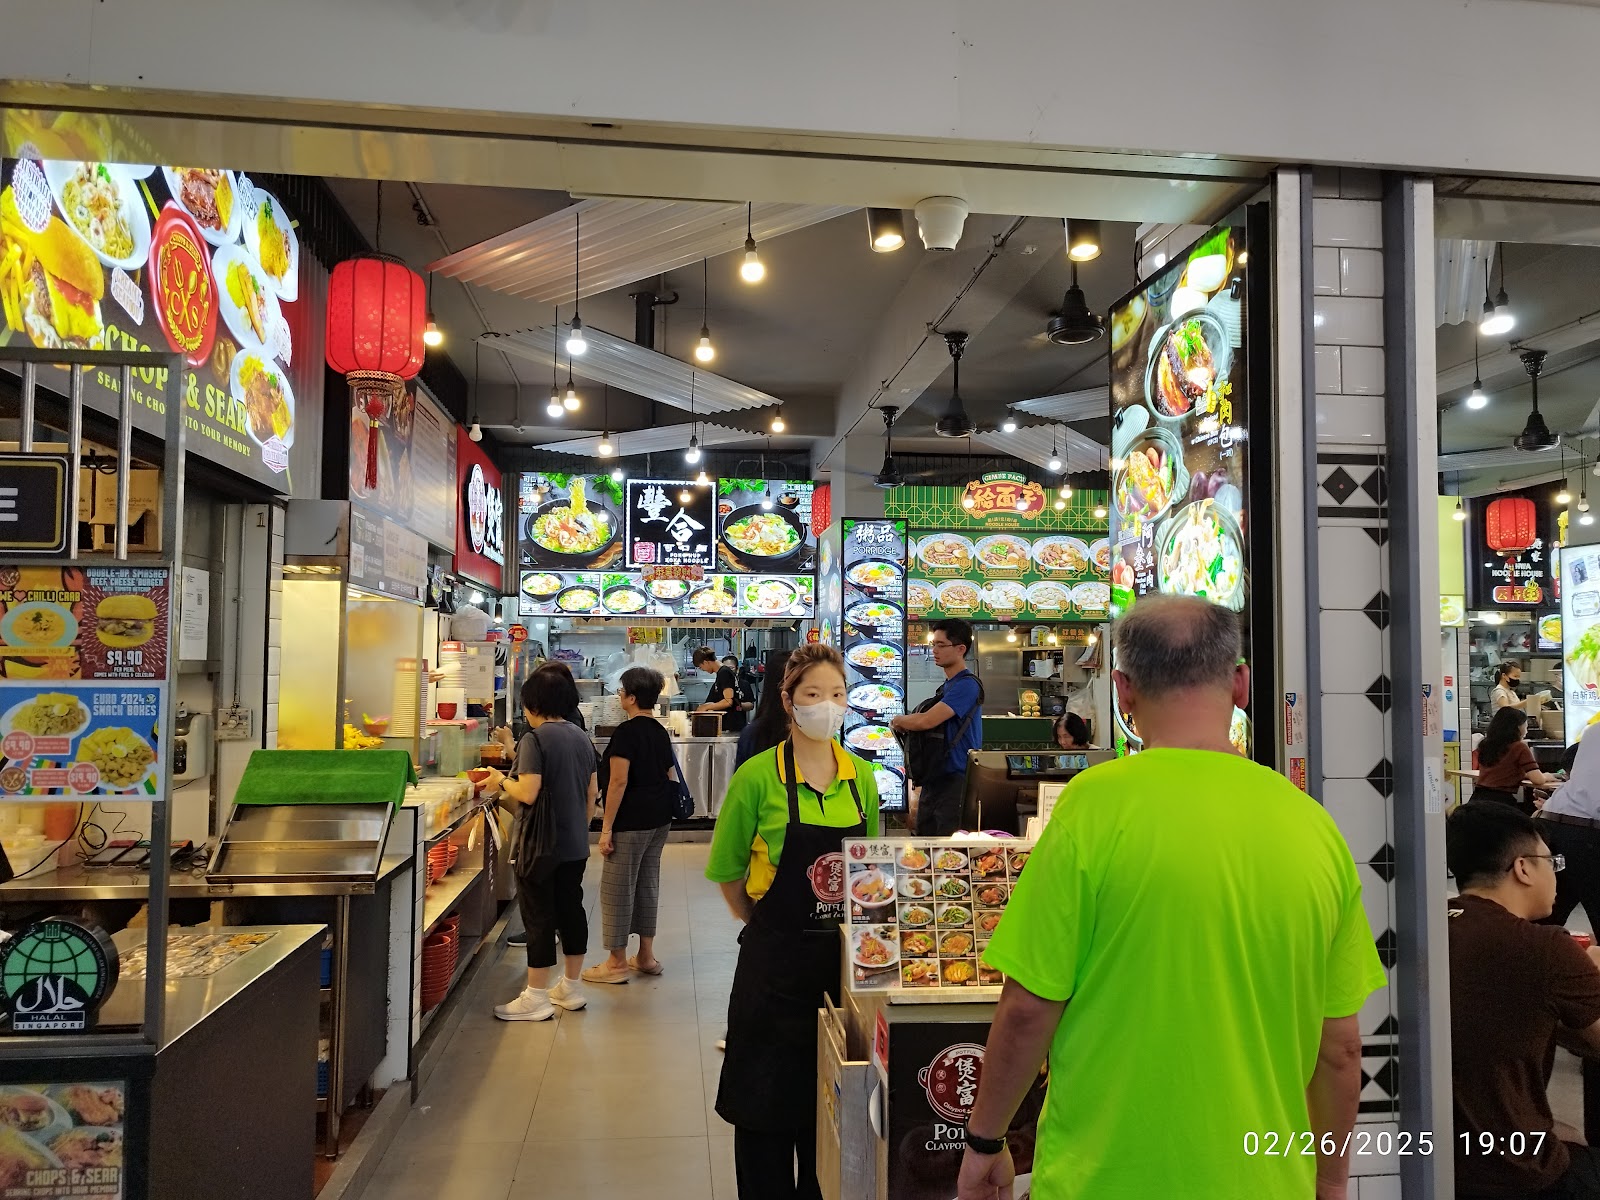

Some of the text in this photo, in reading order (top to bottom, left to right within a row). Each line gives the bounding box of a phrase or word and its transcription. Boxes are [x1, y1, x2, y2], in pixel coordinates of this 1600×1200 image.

[105, 325, 247, 436] CHOP & SEAR
[97, 371, 143, 404] SEANG
[201, 425, 221, 442] YOUR
[223, 434, 250, 456] MEMORY
[856, 523, 893, 544] 粥品
[854, 546, 897, 555] PORRIDGE
[132, 569, 168, 578] SMASHED
[1521, 570, 1543, 578] HOUSE
[110, 577, 136, 586] CHEESE
[137, 578, 163, 587] BURGER
[27, 591, 55, 602] CHILLI
[58, 591, 81, 602] CRAB
[106, 650, 143, 666] $9.90
[93, 693, 145, 705] EURO 2024
[93, 705, 156, 716] SNACK BOXES
[4, 740, 31, 751] $9.90
[816, 901, 845, 913] POTFU
[955, 1058, 977, 1106] 煲富
[934, 1123, 965, 1140] POT
[925, 1140, 967, 1151] CLAYPOT
[26, 1169, 67, 1186] CHOPS
[85, 1167, 118, 1183] SEAR
